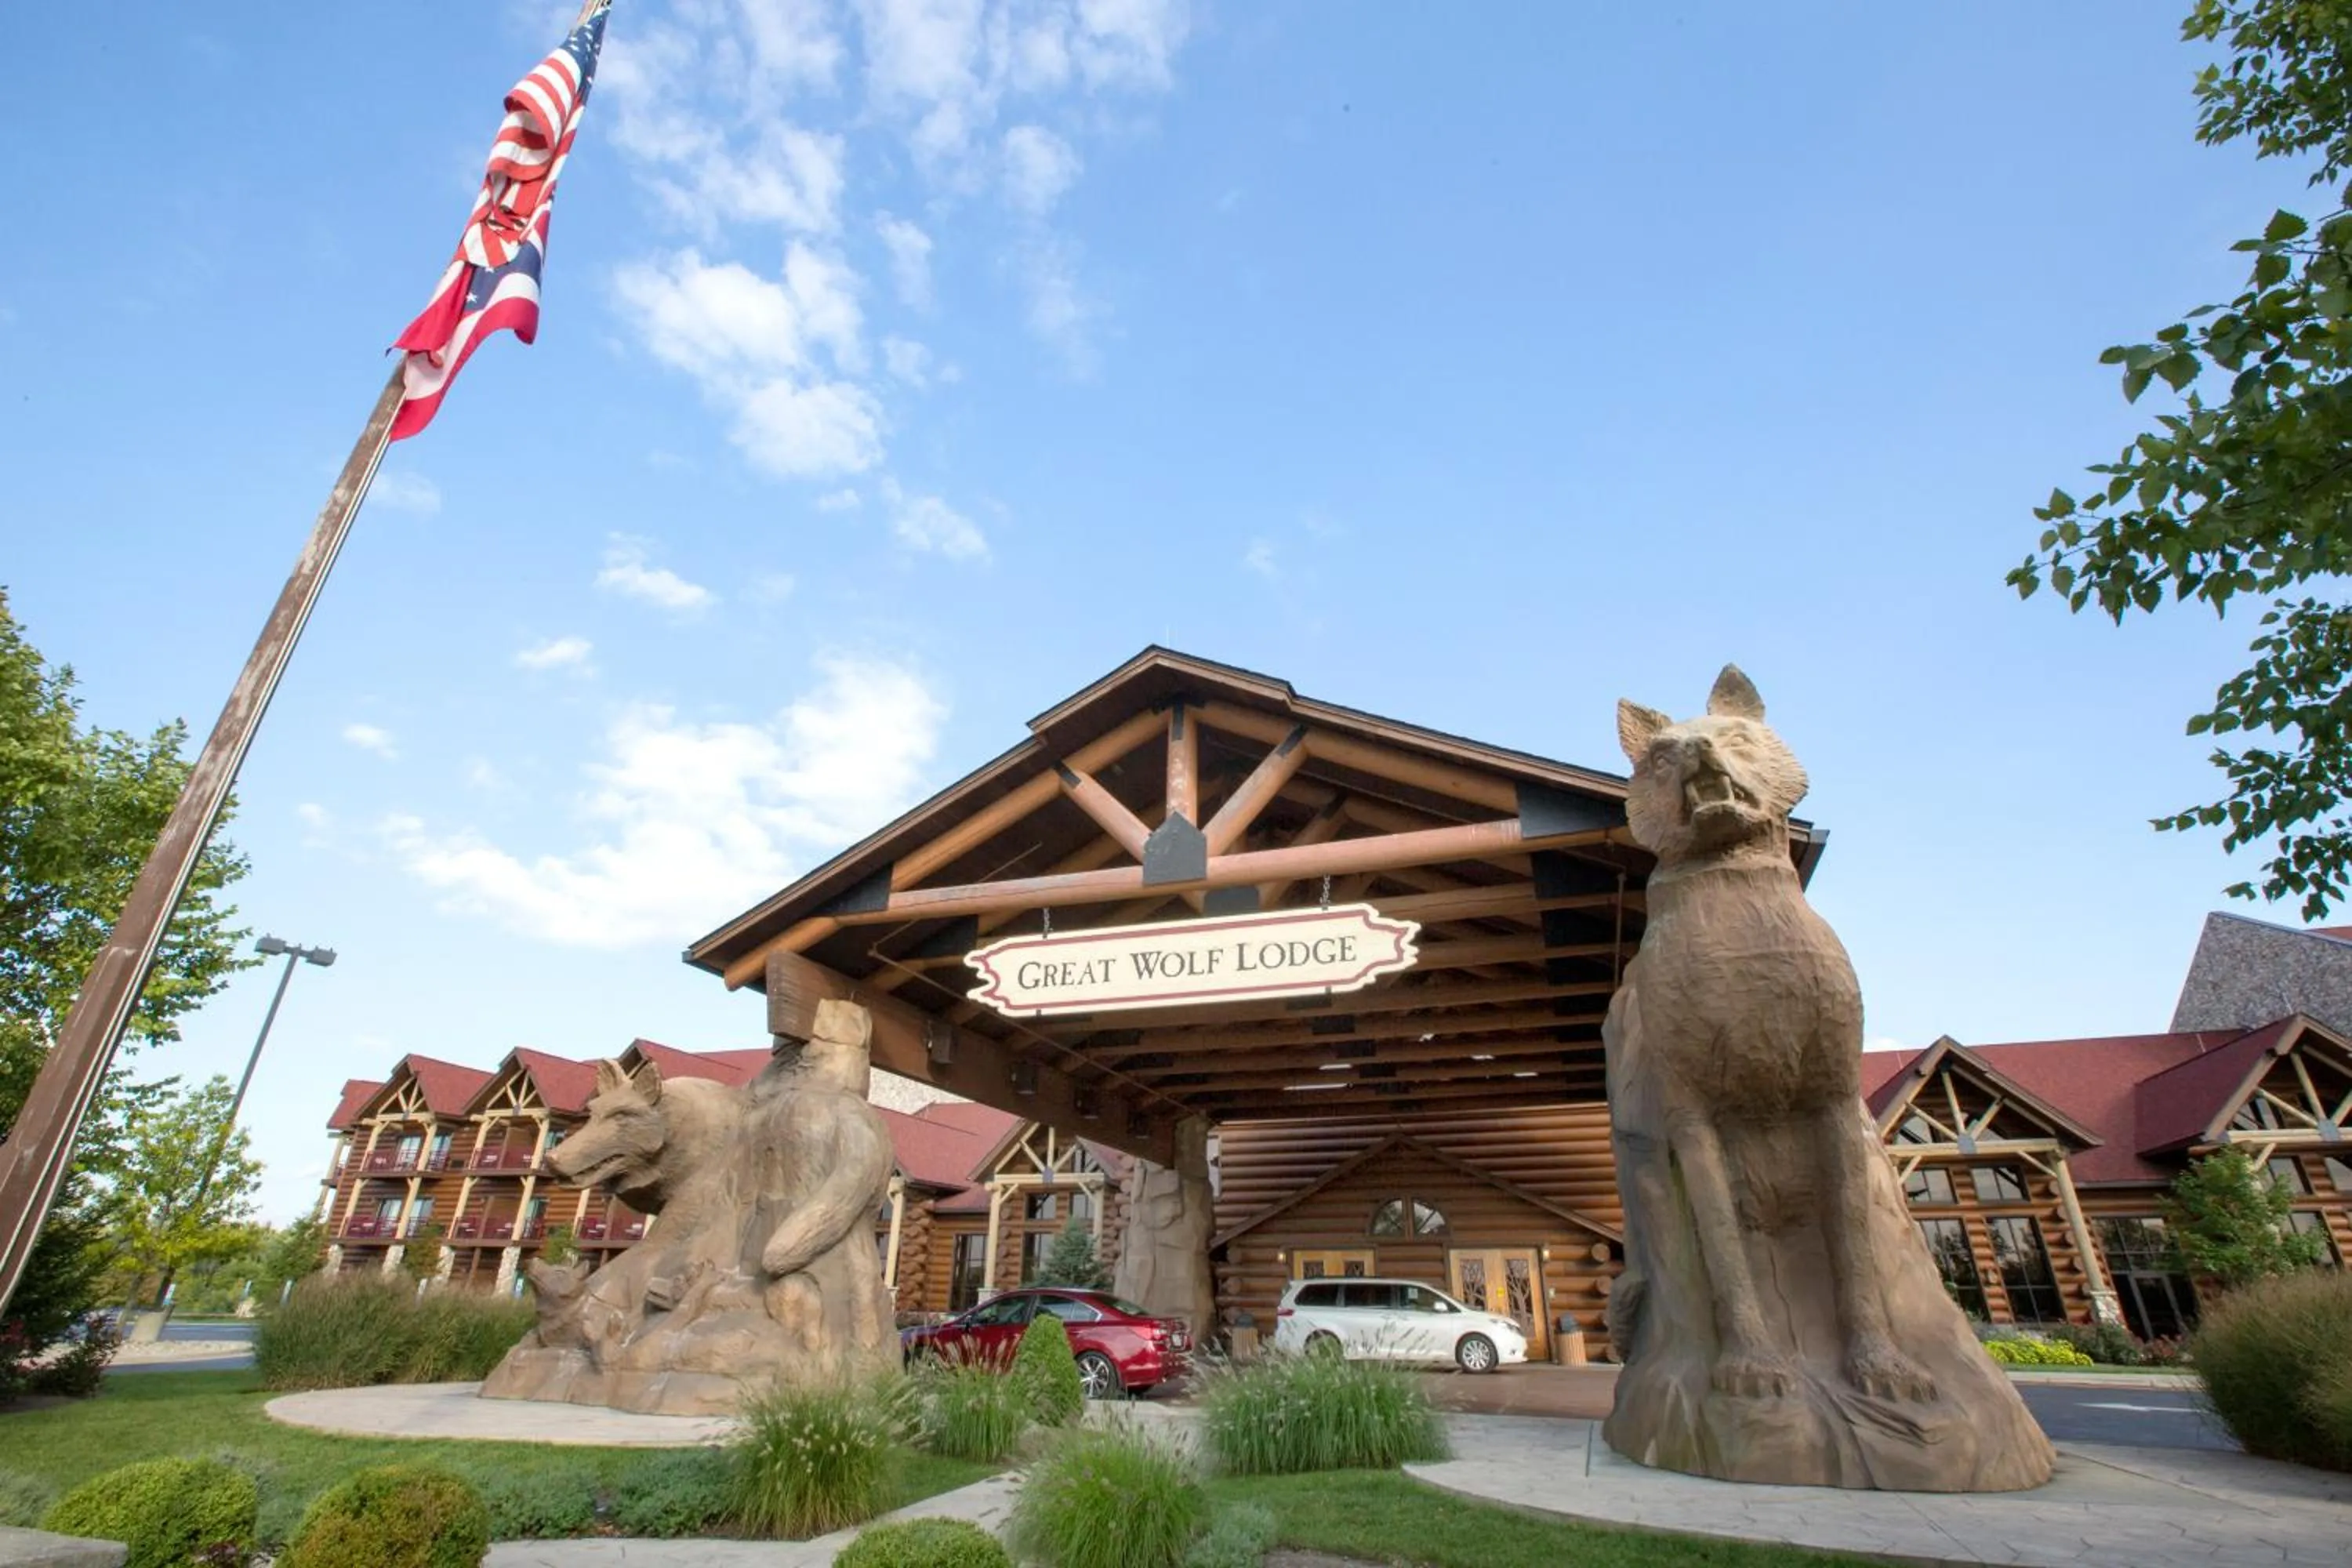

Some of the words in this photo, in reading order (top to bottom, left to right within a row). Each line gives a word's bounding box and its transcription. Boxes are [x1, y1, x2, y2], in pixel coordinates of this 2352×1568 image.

[1018, 958, 1116, 990] GREAT
[1130, 948, 1223, 980] WOLF
[1236, 935, 1356, 971] LODGE
